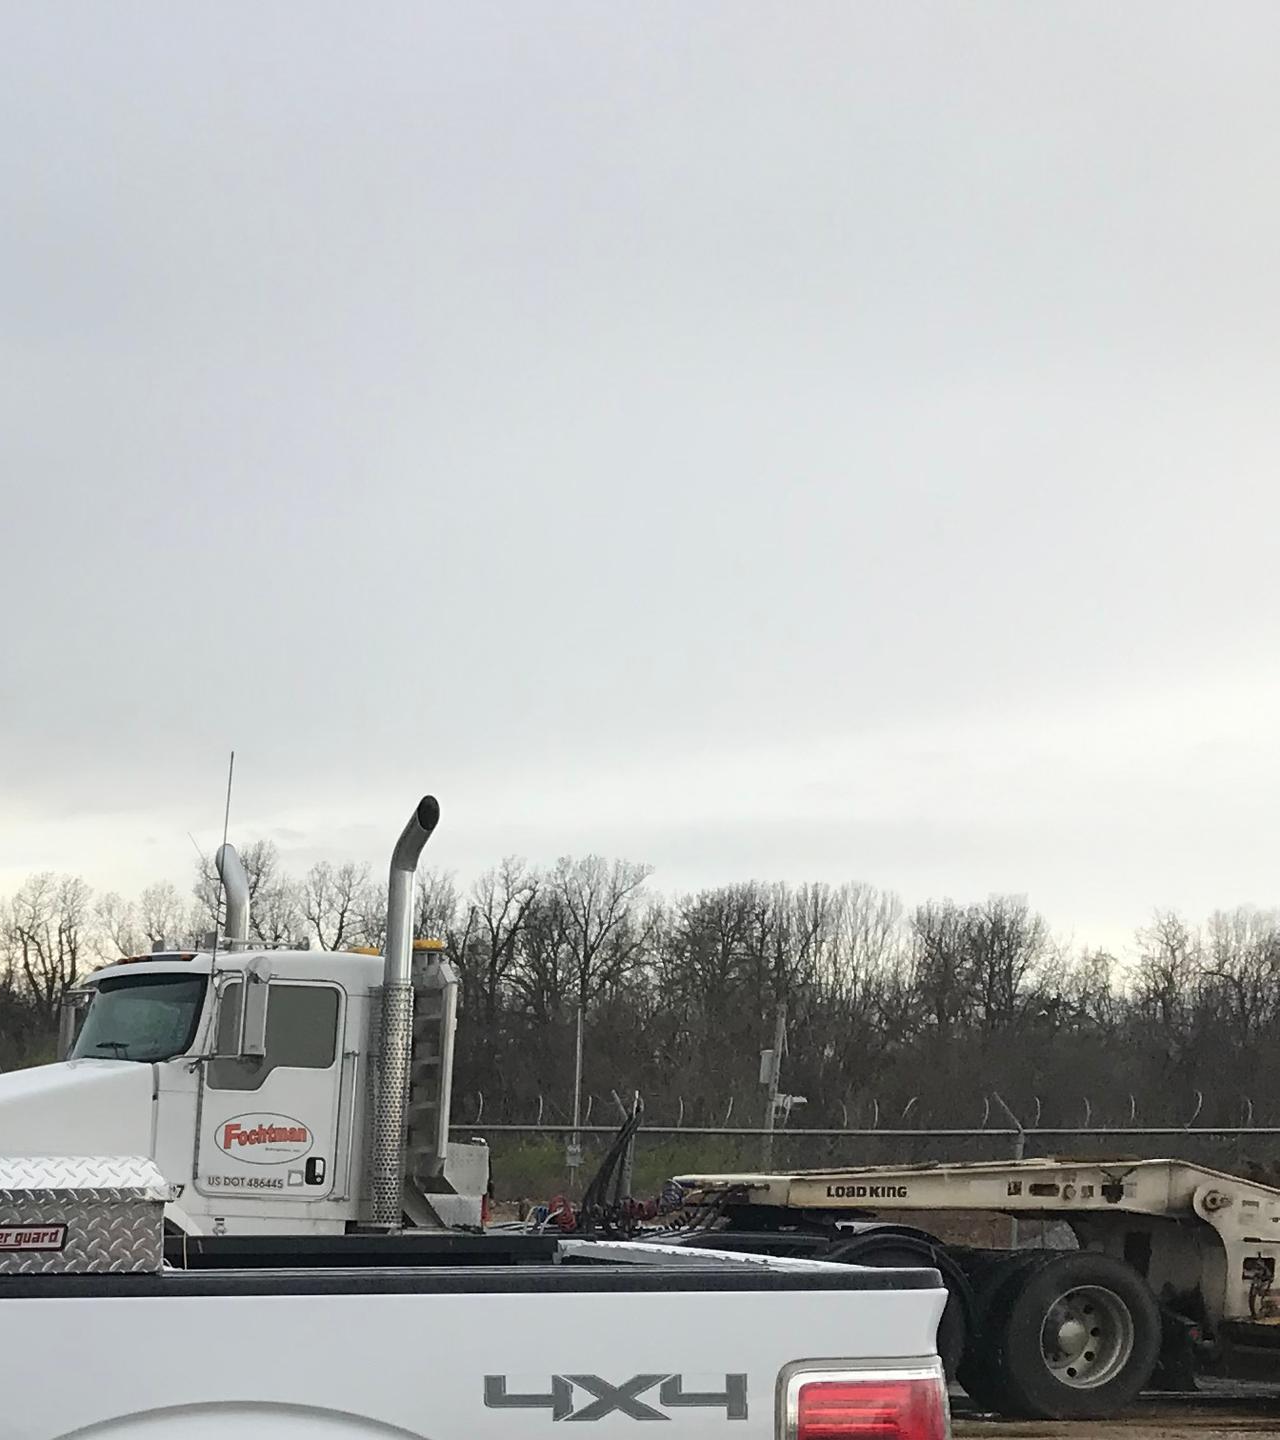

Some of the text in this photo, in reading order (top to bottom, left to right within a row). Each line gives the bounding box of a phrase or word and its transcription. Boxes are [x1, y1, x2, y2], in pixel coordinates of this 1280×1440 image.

[224, 1123, 307, 1149] Fochtman
[207, 1176, 284, 1190] US DOT 486445
[14, 1229, 60, 1246] guard
